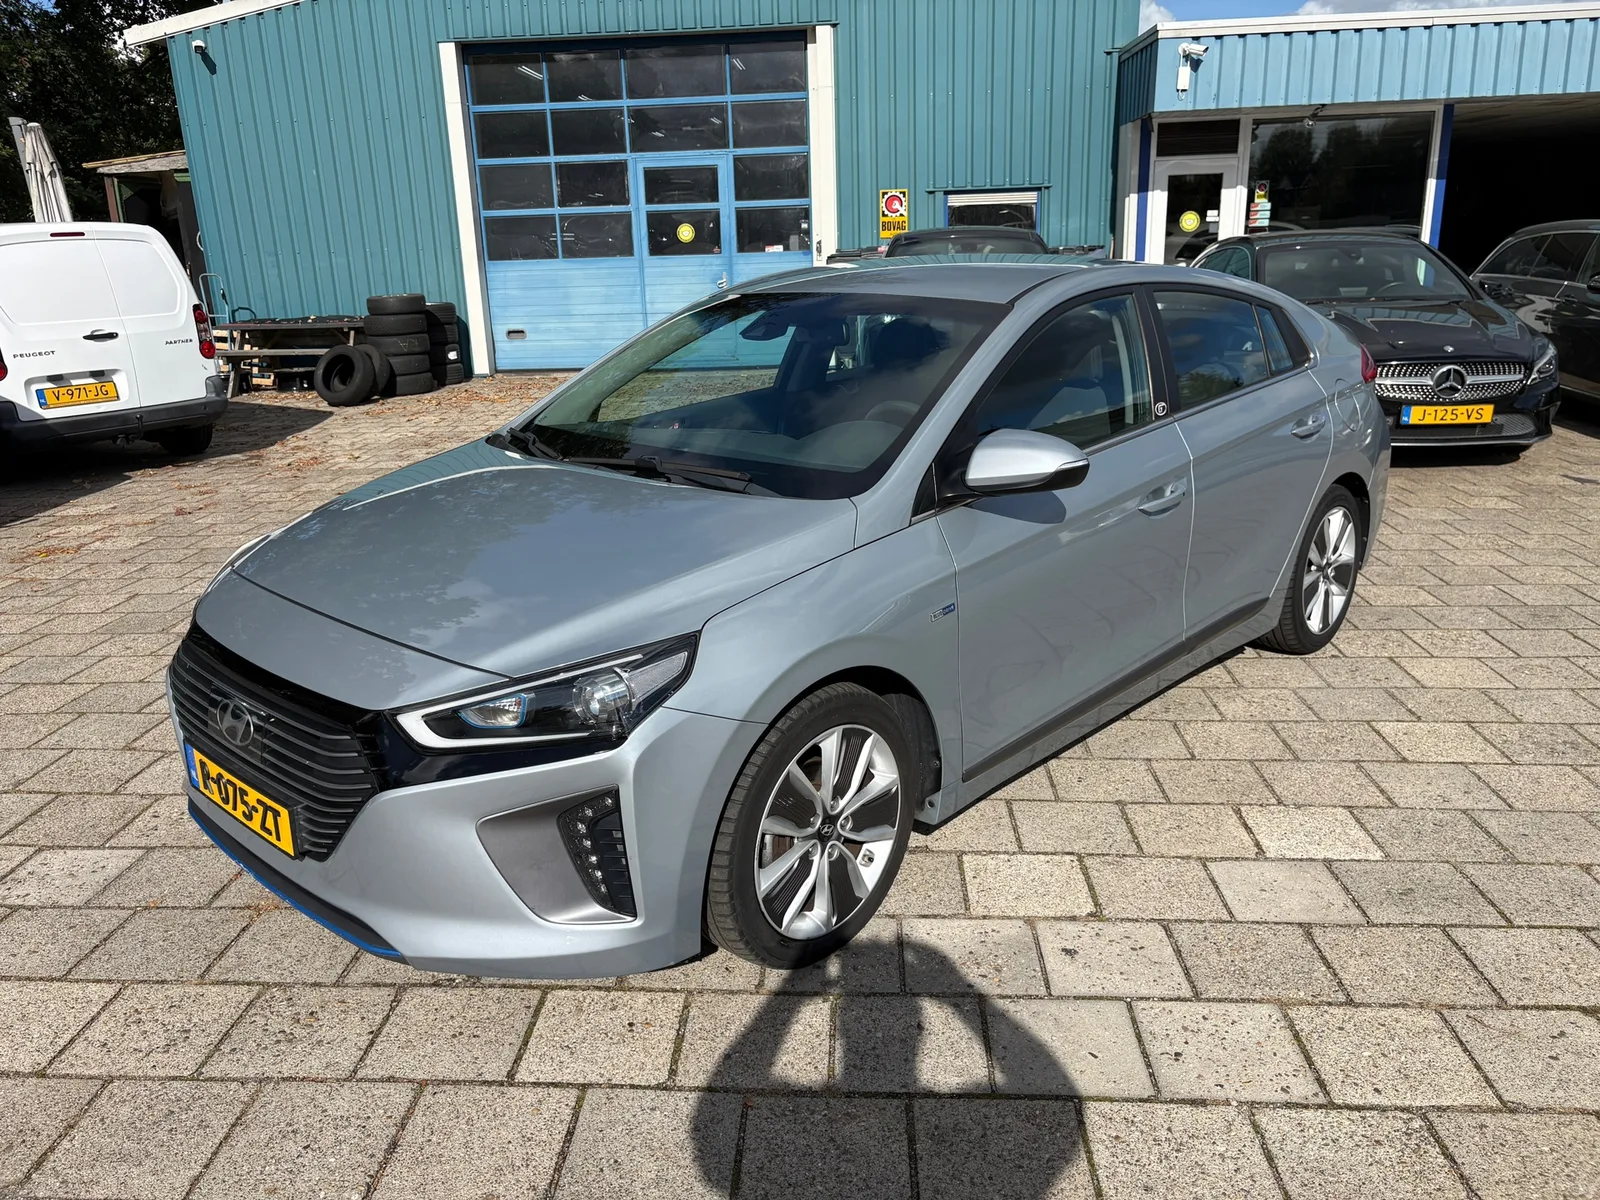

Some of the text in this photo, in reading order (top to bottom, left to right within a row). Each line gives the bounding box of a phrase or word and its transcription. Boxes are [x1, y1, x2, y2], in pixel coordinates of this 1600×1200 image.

[882, 221, 906, 231] BOVAG
[13, 350, 56, 359] PEUGEOT
[52, 385, 109, 401] V-971-JG
[1418, 408, 1484, 422] J-125-VS
[199, 759, 282, 842] R-075-ZT
